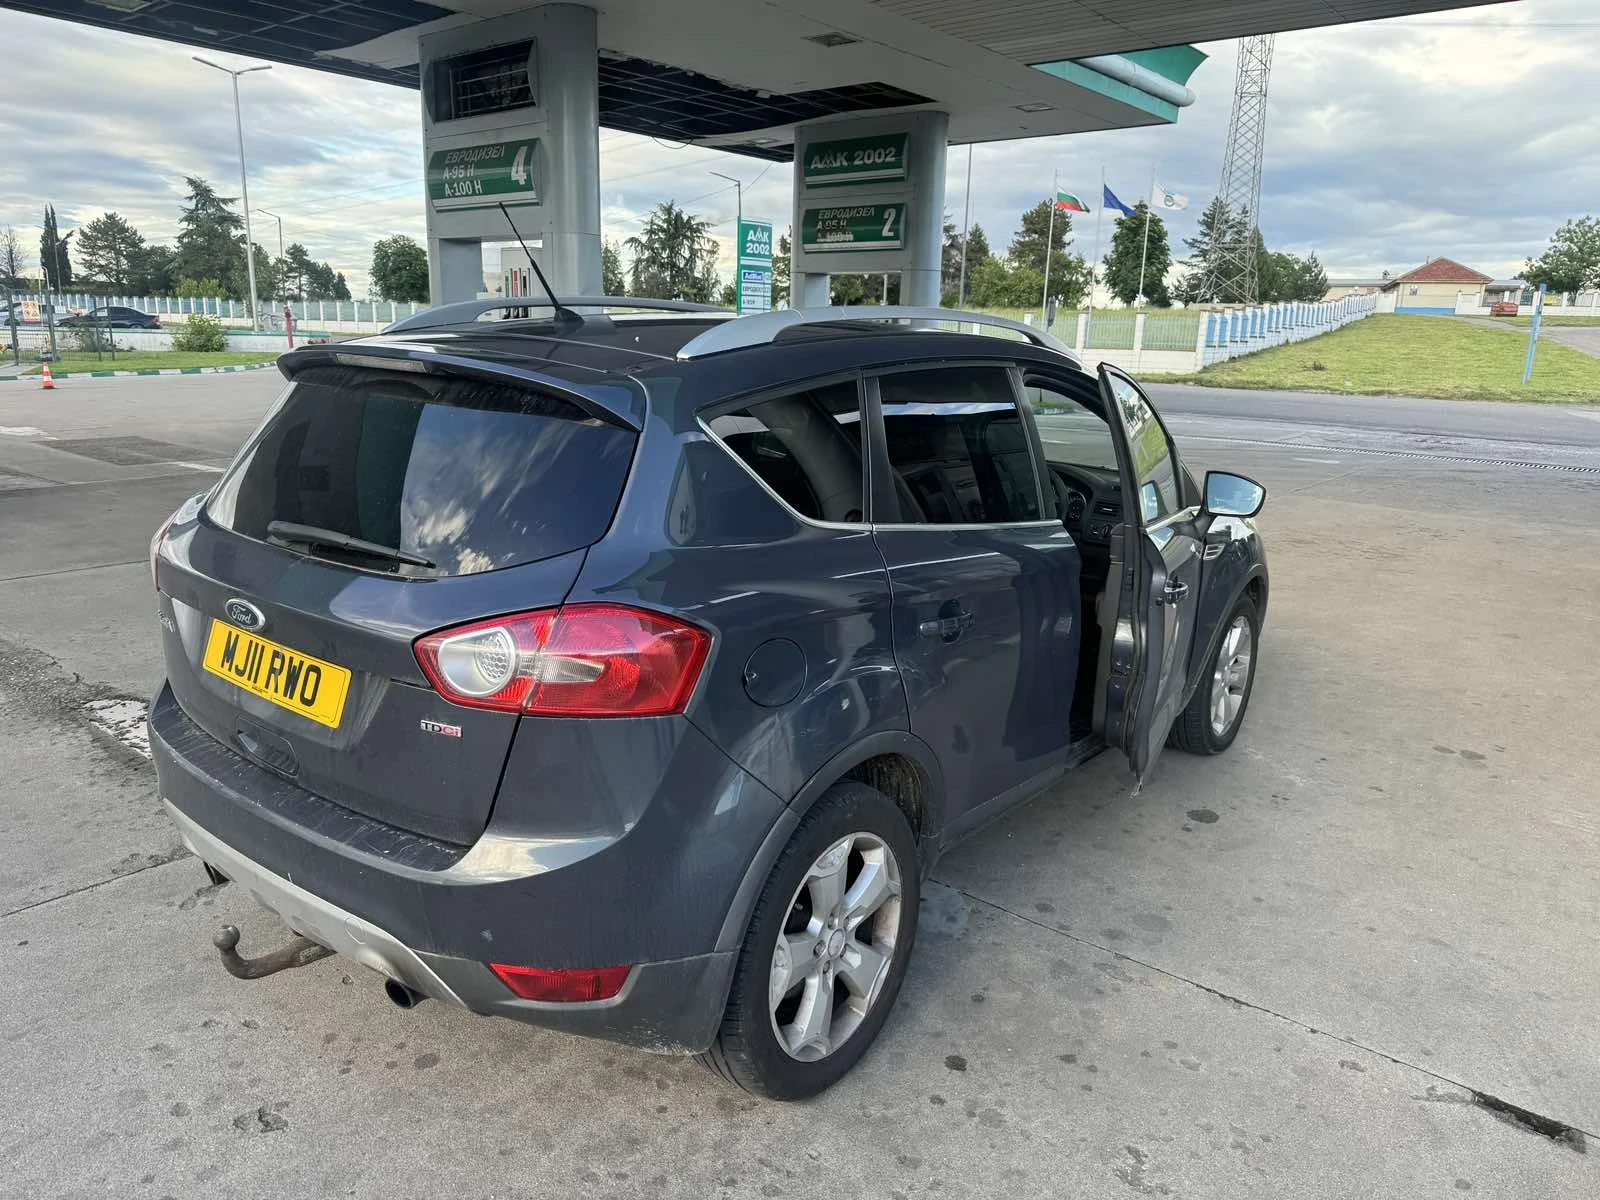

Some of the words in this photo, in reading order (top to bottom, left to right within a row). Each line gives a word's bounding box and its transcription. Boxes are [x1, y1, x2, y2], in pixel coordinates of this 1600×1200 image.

[445, 146, 505, 164] ЕВРОДИЗЕЛ
[853, 147, 897, 165] 2002
[443, 165, 465, 180] А-95
[511, 146, 528, 185] 4
[444, 182, 472, 197] А-100
[474, 180, 483, 194] Н
[818, 207, 875, 219] ЕВРОДИЗЕЛ
[882, 208, 896, 237] 2
[746, 243, 770, 255] 2002
[232, 604, 251, 624] Ford
[220, 630, 266, 685] MJ11
[265, 652, 322, 707] RWO
[421, 721, 460, 737] TDCi
